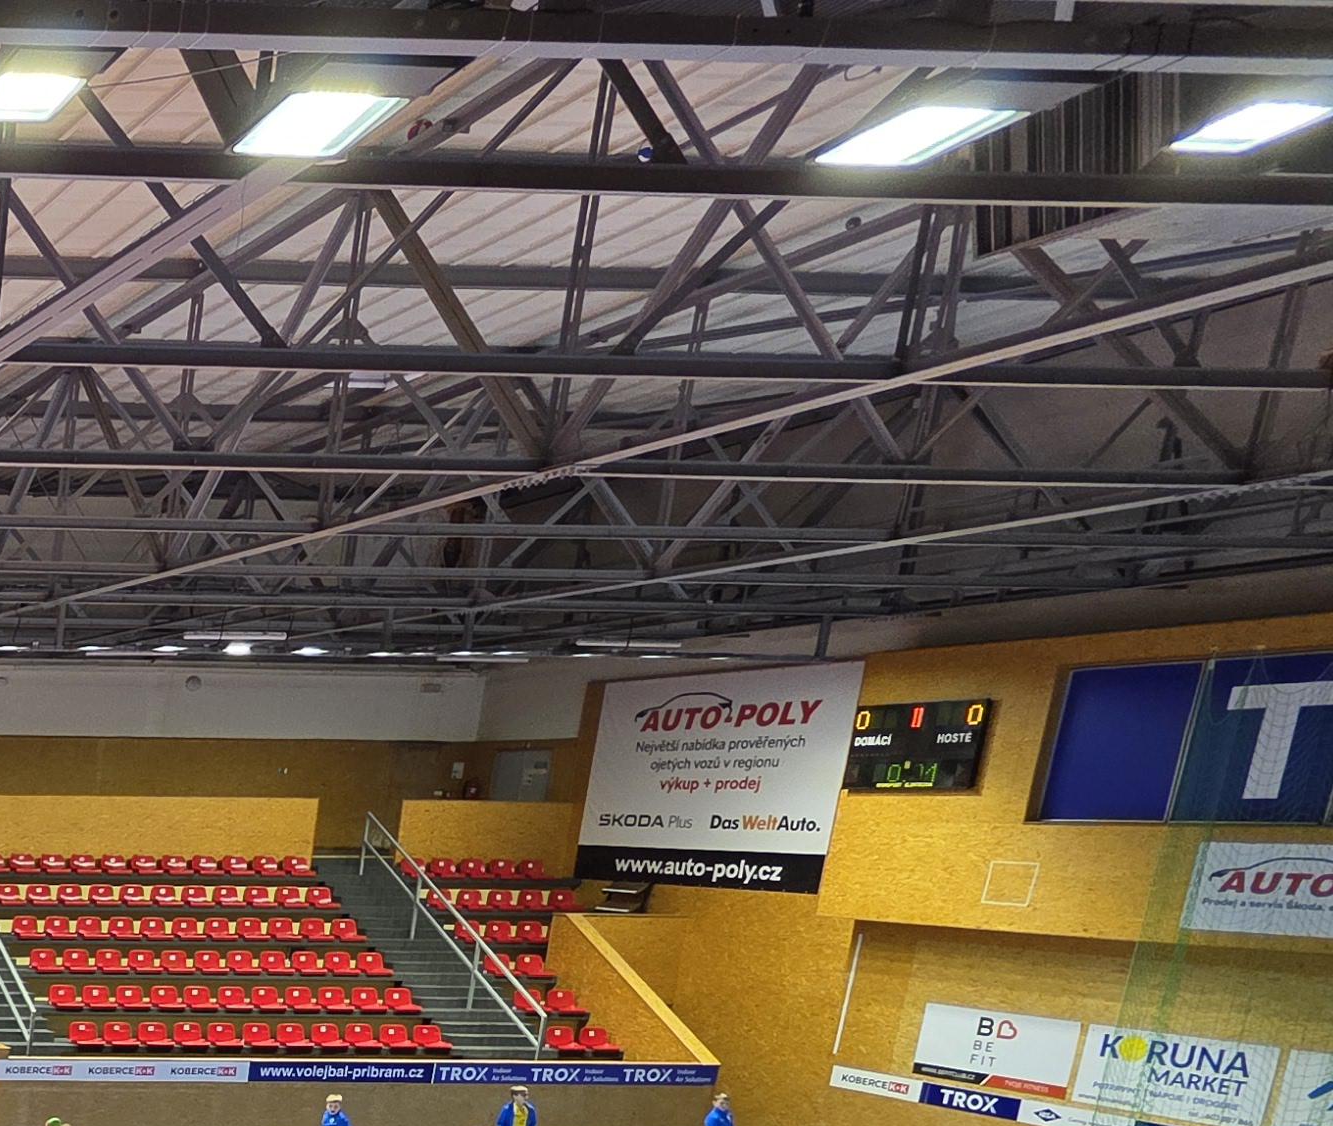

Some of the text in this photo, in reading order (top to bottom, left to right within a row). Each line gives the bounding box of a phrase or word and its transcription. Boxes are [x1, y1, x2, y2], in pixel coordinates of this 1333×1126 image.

[967, 704, 984, 726] 0
[636, 735, 806, 753] Největší nabídka prověřených
[650, 756, 780, 770] ojetých vozů v regionu
[660, 775, 762, 793] výkup + prodej
[666, 814, 693, 829] Plus
[709, 815, 739, 830] Das
[615, 857, 782, 884] www.auto-poly.cz
[973, 1040, 994, 1053] BE
[969, 1054, 996, 1068] FIT
[5, 1066, 52, 1075] KOBERCE
[88, 1066, 134, 1075] KOBERCE
[170, 1066, 217, 1075] KOBERCE
[260, 1065, 425, 1080] www.volejbal-pribram.cz
[439, 1066, 489, 1081] TROX
[531, 1067, 581, 1082] TROX
[623, 1068, 673, 1083] TROX
[841, 1073, 888, 1090] KOBERCE
[1147, 1067, 1247, 1097] MARKET
[939, 1088, 999, 1114] TROX
